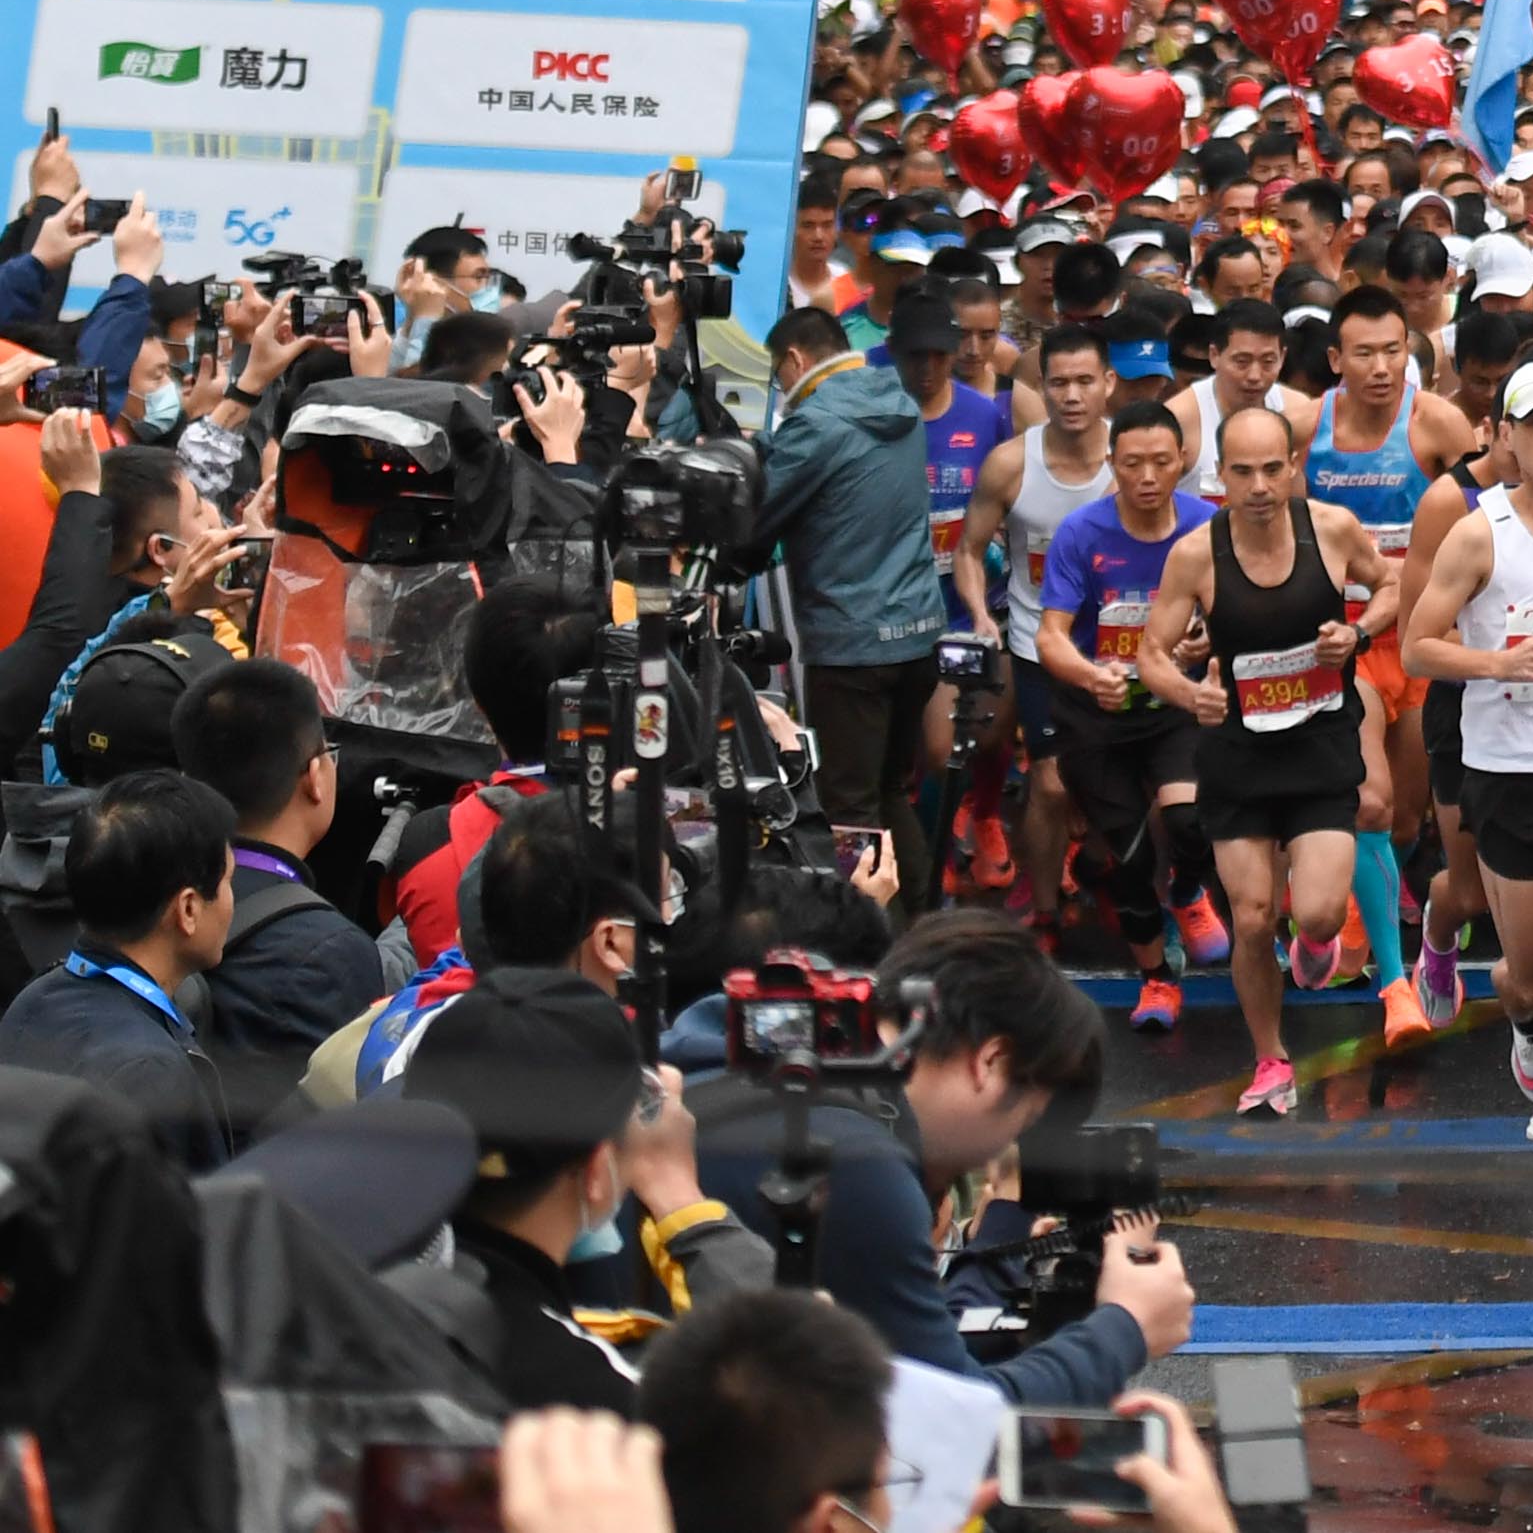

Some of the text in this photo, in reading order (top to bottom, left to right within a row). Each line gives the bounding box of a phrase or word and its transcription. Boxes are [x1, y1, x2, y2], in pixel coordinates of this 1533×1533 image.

[219, 46, 309, 91] 魔力
[531, 49, 611, 84] PICC
[476, 88, 661, 119] 中国人民保险
[1314, 468, 1407, 492] Speedster
[585, 744, 607, 831] SONY
